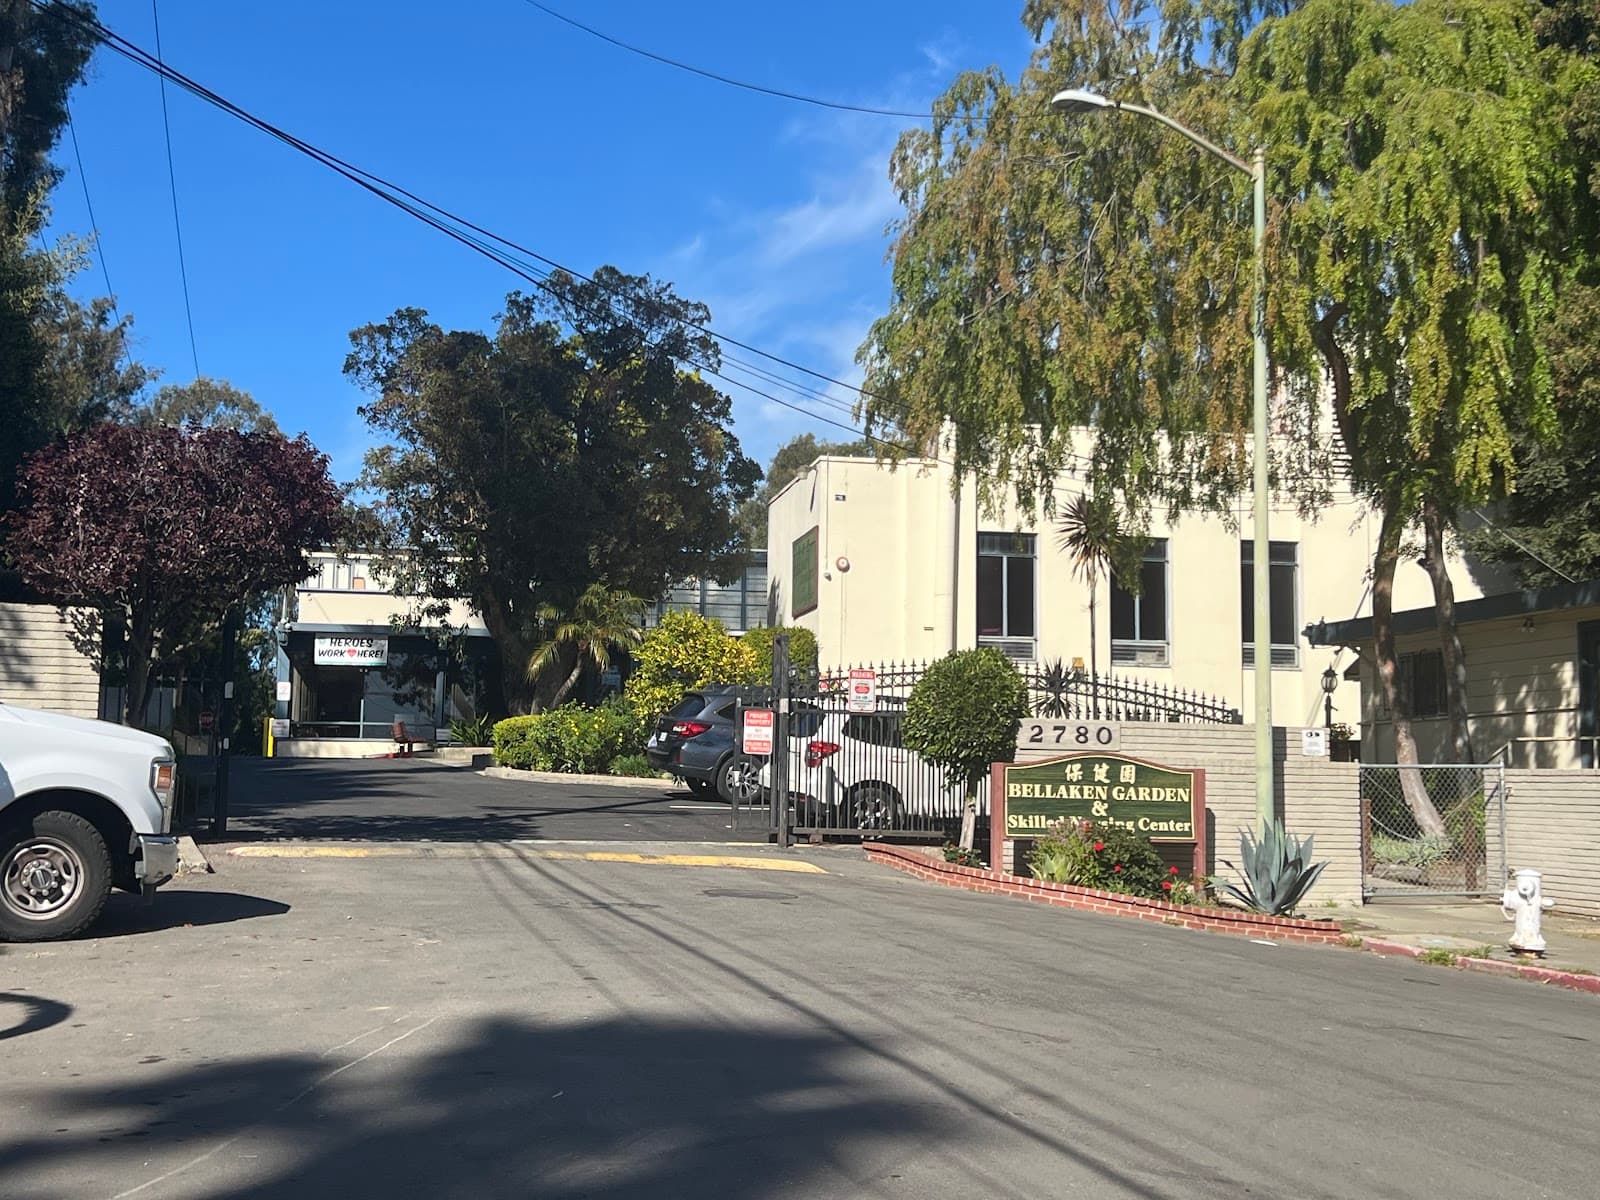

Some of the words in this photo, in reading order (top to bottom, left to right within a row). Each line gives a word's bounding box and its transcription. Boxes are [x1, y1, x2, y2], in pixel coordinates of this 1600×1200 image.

[329, 637, 374, 648] HEROES
[318, 648, 347, 658] WORK
[357, 649, 385, 659] HERE!
[1029, 725, 1113, 745] 2780
[1008, 783, 1109, 801] BELLAKEN
[1112, 786, 1191, 802] GARDEN
[1091, 800, 1109, 817] &
[1138, 817, 1191, 832] Center
